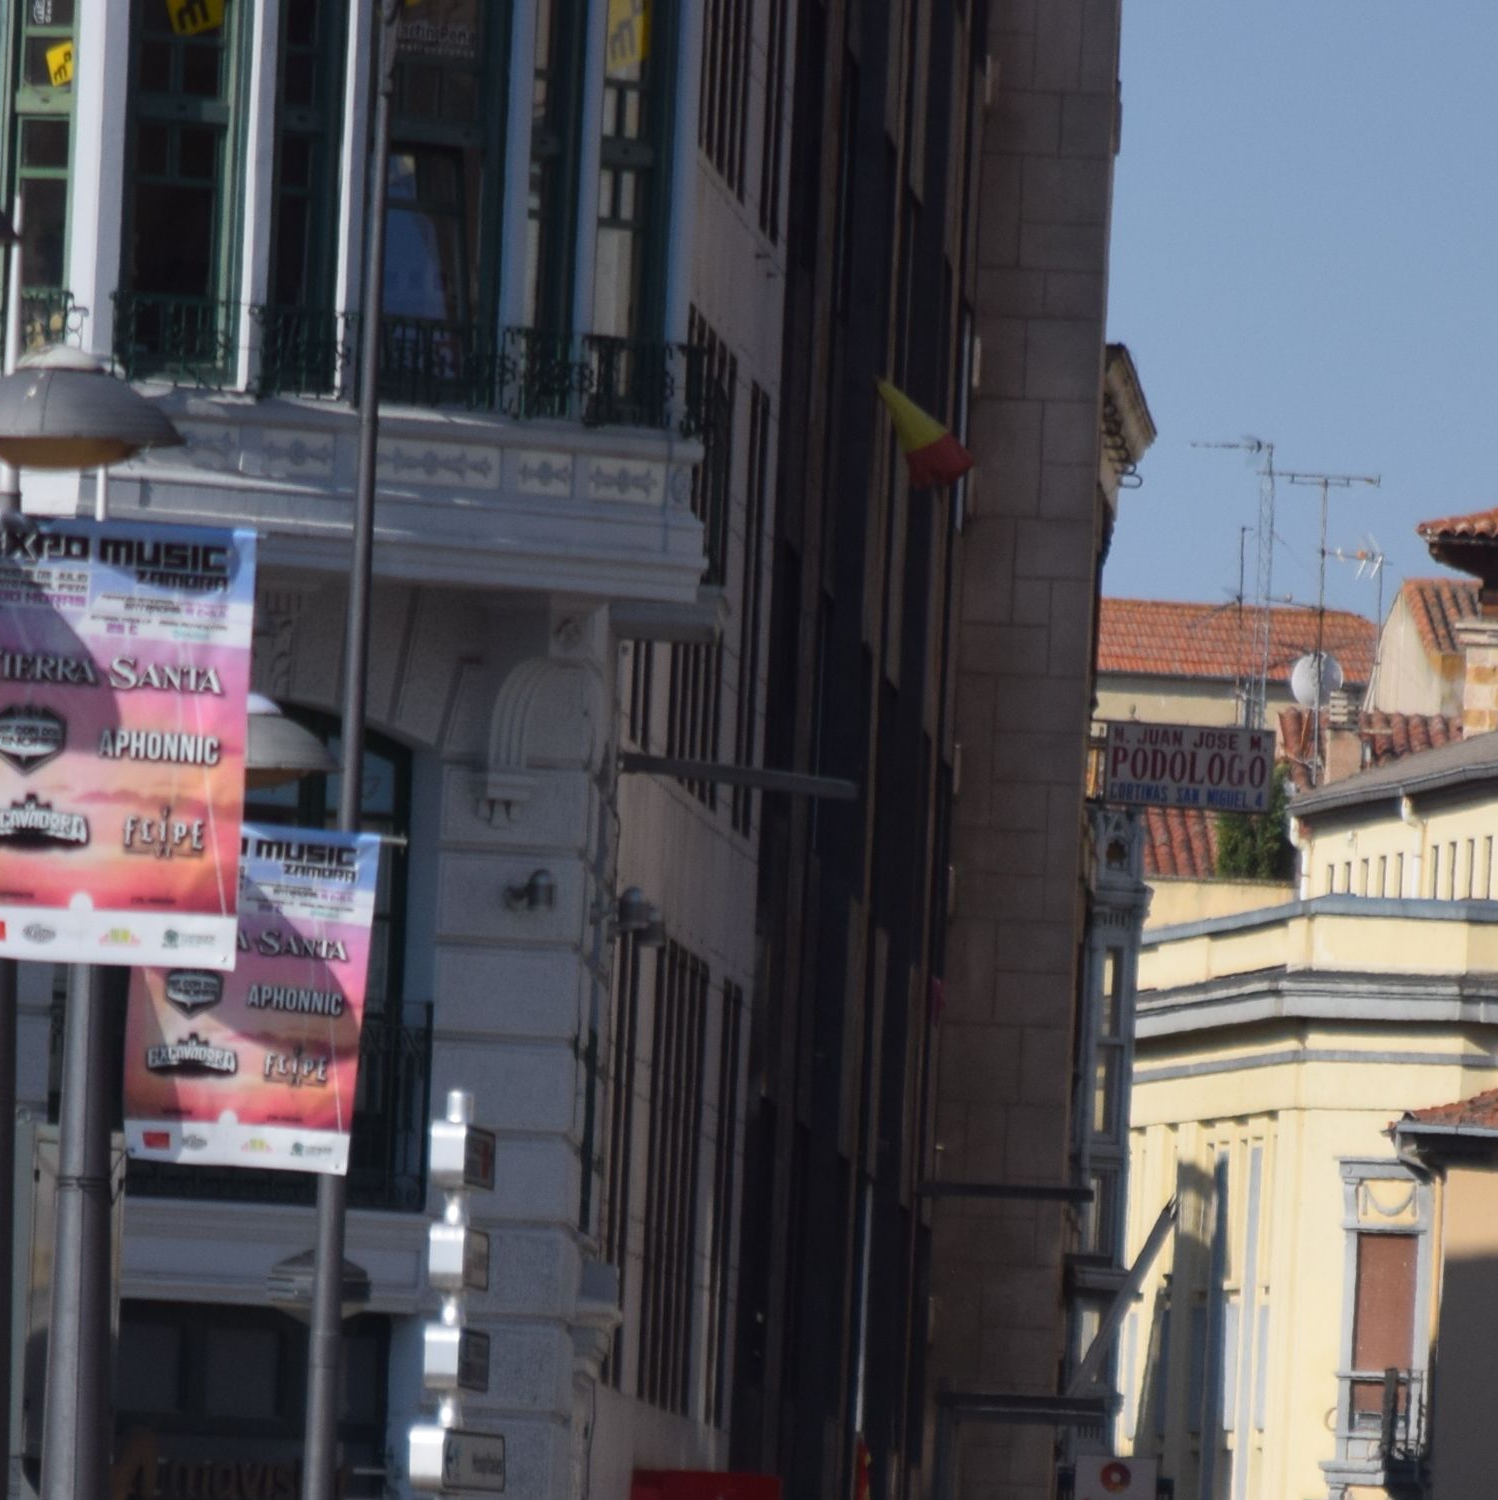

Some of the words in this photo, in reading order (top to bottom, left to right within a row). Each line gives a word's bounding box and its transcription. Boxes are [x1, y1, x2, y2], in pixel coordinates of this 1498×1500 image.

[99, 538, 229, 573] MUSIC
[135, 570, 229, 593] ZAMORA
[108, 655, 223, 696] SANTA
[98, 729, 222, 766] APHONNIC
[1137, 729, 1184, 749] JUAN
[1193, 730, 1239, 750] JOSE
[1110, 746, 1268, 790] PODOLOGO
[1175, 785, 1200, 802] SAN
[256, 842, 360, 869] MUSIC
[284, 864, 359, 883] ZAMORA
[259, 929, 349, 962] SANTA
[247, 984, 345, 1016] APHONNIC
